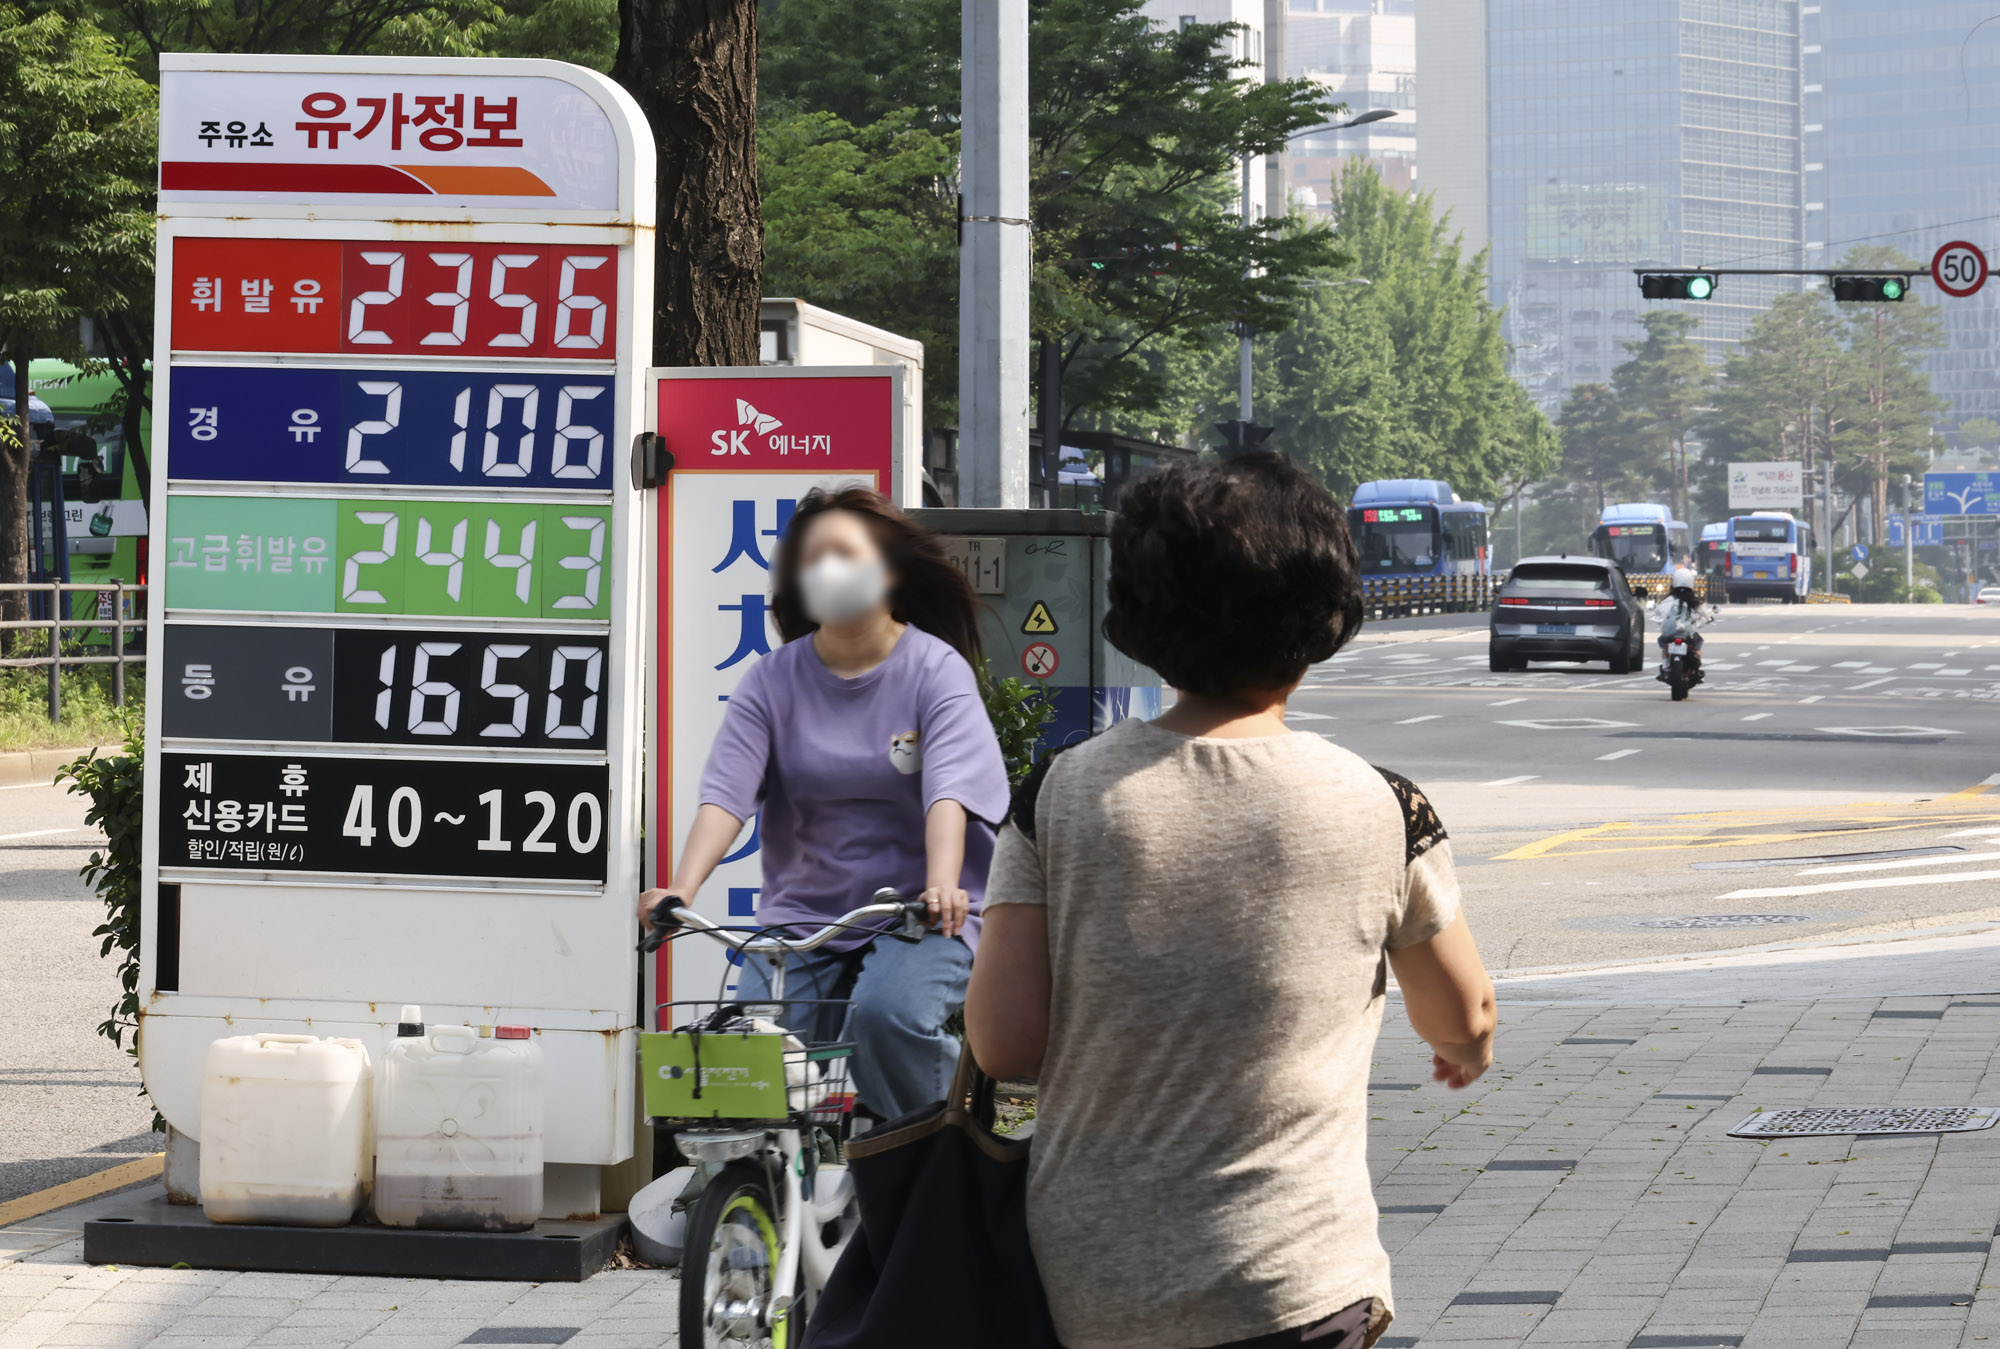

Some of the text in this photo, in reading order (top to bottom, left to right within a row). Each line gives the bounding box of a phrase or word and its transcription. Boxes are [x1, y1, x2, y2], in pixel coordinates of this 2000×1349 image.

[198, 92, 524, 152] 주유소 유가정보
[1943, 255, 1976, 283] 50
[190, 252, 609, 350] 휘발유 2356
[345, 381, 606, 480] 2106
[711, 430, 831, 456] SK 에너지
[168, 511, 606, 610] 고급휘발유 2443
[968, 541, 980, 552] TR
[374, 642, 603, 740] 1650
[182, 799, 309, 833] 신용카드
